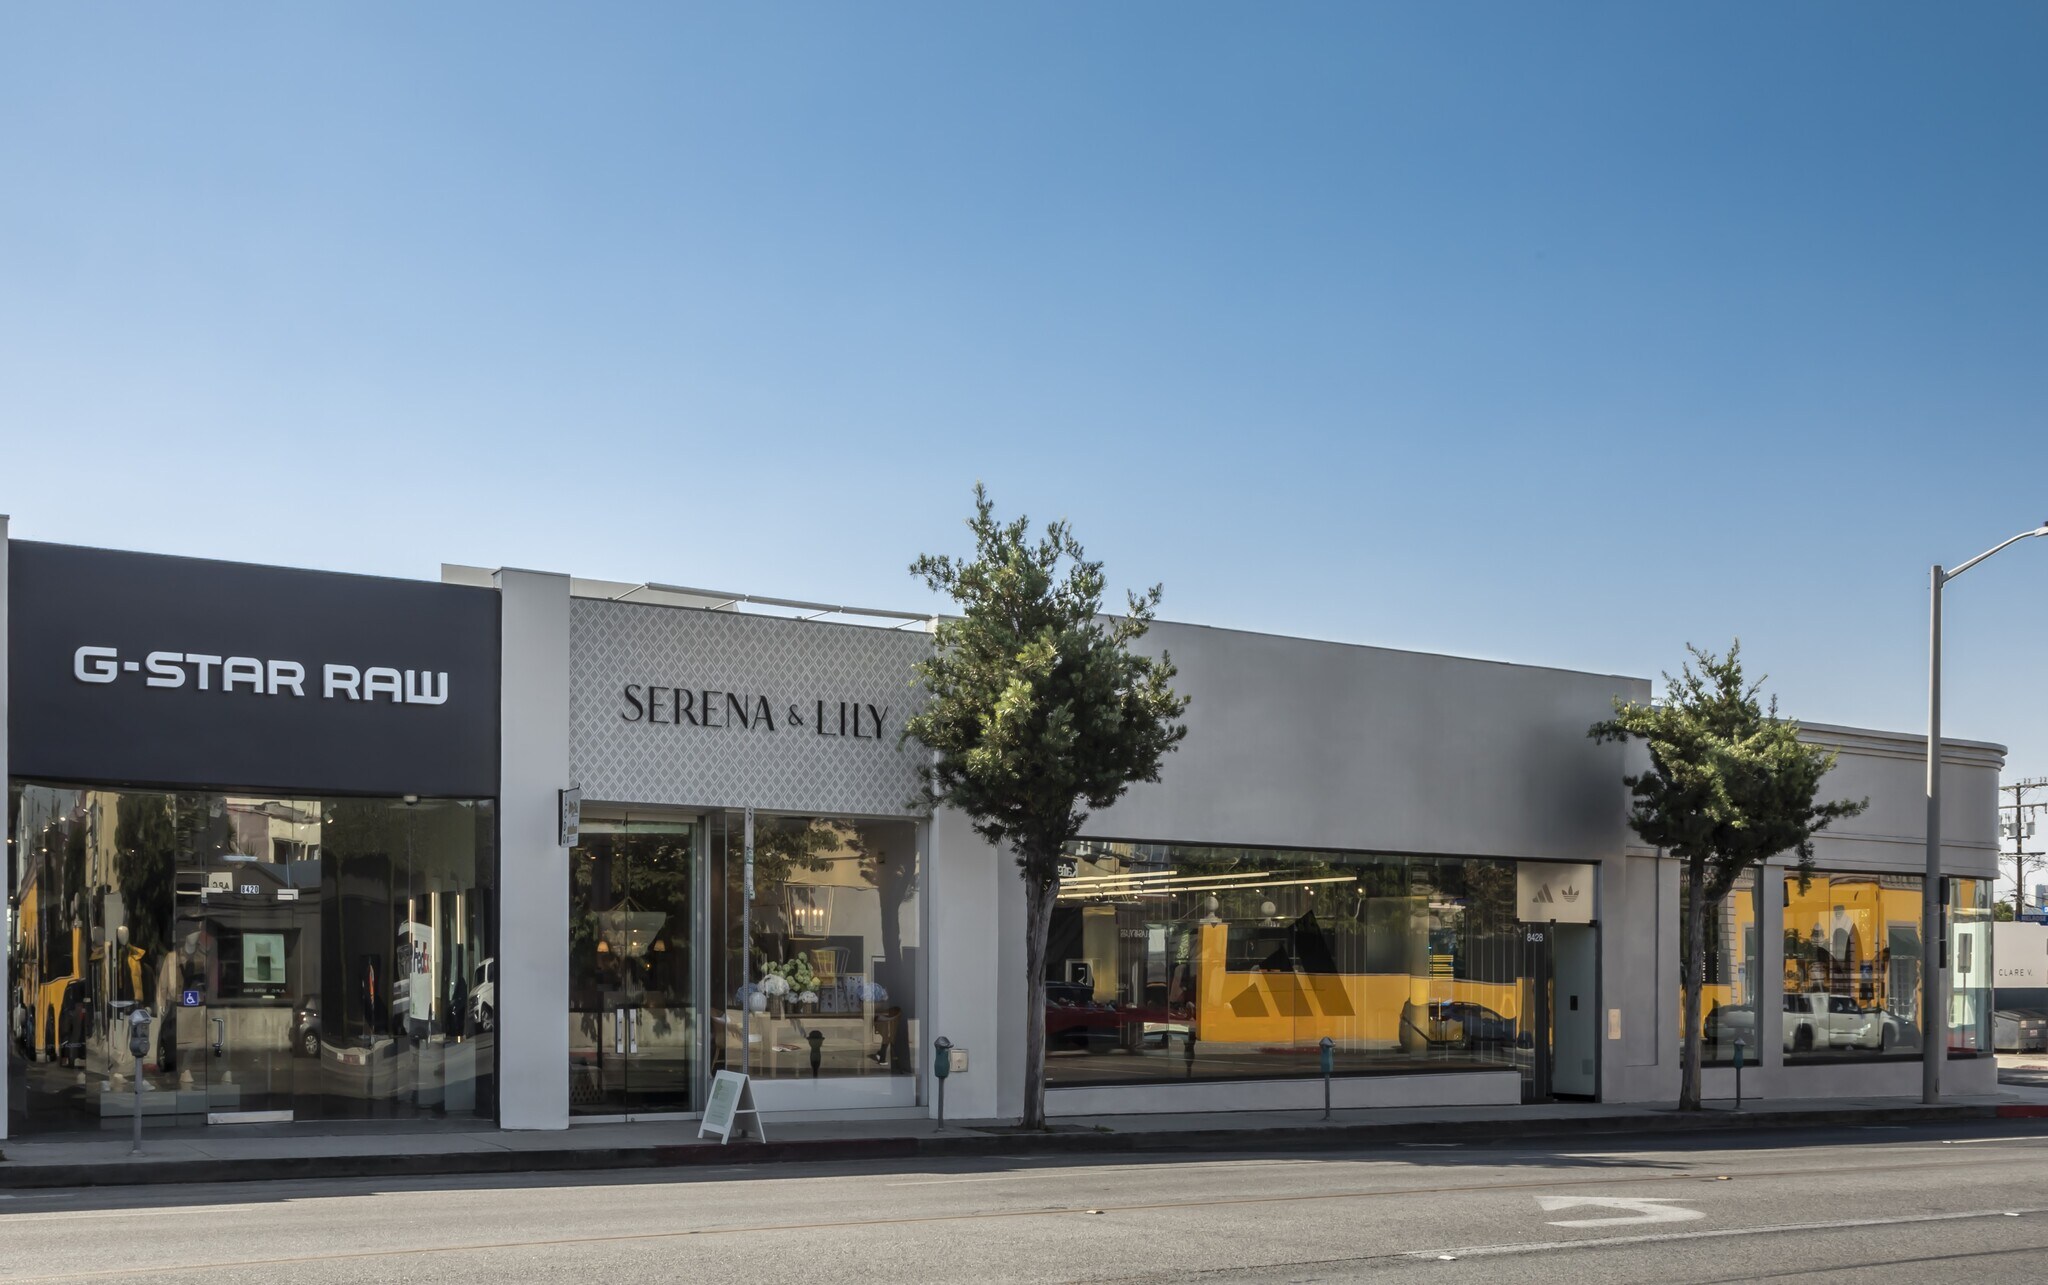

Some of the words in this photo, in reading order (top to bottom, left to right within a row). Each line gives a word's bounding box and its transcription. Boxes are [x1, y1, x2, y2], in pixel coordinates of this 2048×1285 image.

[74, 645, 305, 697] G-STAR
[323, 663, 449, 705] RAW
[622, 684, 775, 732] SERENA
[788, 704, 804, 726] &
[817, 700, 888, 739] LILY
[241, 885, 259, 894] 8420
[1526, 932, 1544, 942] 8428
[1998, 968, 2024, 977] CLARE
[2027, 969, 2033, 977] V.
